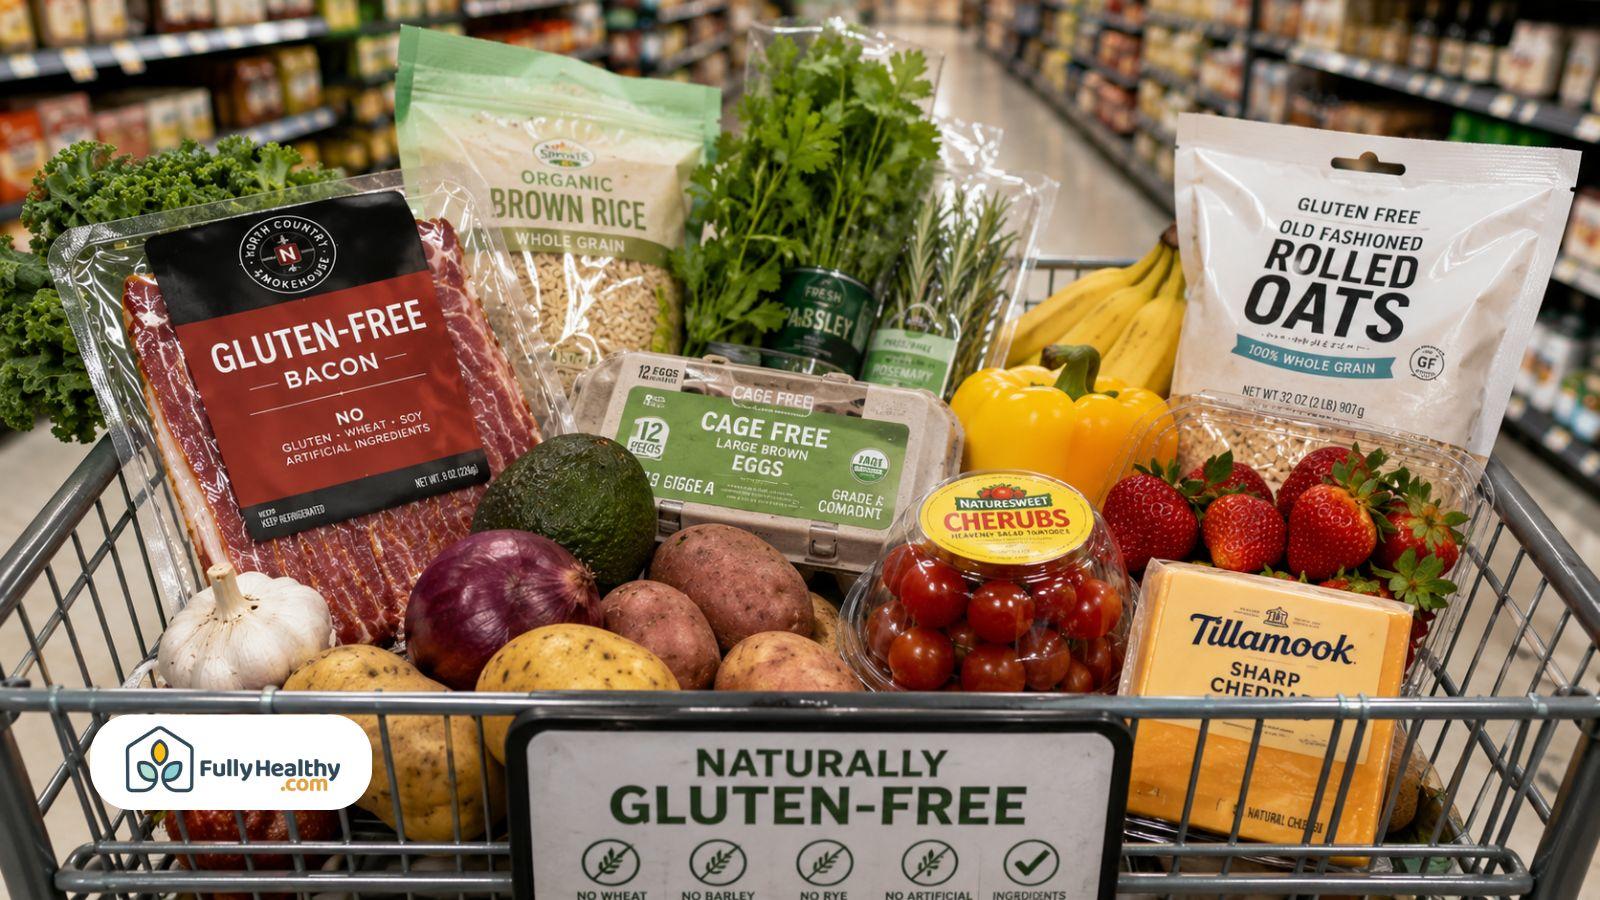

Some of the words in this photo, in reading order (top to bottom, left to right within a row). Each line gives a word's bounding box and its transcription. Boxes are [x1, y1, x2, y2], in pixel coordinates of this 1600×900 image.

[521, 170, 613, 192] ORGANIC
[490, 187, 584, 224] BROWN
[591, 197, 647, 231] RICE
[1297, 197, 1369, 220] GLUTEN
[1374, 207, 1421, 224] FREE
[245, 225, 271, 258] NORTH
[273, 219, 328, 247] COUNTRY
[515, 231, 571, 248] WHOLE
[576, 235, 625, 253] GRAIN
[1279, 220, 1315, 238] OLD
[1319, 227, 1423, 251] FASHIONED
[279, 246, 297, 262] N
[1264, 238, 1419, 289] ROLLED
[805, 286, 842, 303] FRESH
[1244, 274, 1411, 343] OATS
[210, 299, 427, 374] GLUTEN-FREE
[1248, 343, 1279, 362] 100%
[1283, 354, 1330, 372] WHOLE
[1334, 360, 1376, 374] GRAIN
[1417, 356, 1437, 369] GF
[284, 352, 379, 390] BACON
[638, 364, 650, 379] 12
[652, 366, 679, 378] EGGS
[732, 385, 772, 404] CAGE
[776, 391, 814, 410] FREE
[1242, 385, 1261, 398] NET
[1263, 388, 1279, 401] WT
[1280, 391, 1293, 404] 32
[1294, 394, 1308, 406] OZ
[1309, 396, 1320, 408] (2
[1321, 398, 1337, 412] LB)
[335, 407, 364, 426] NO
[282, 433, 332, 453] GLUTEN
[344, 420, 386, 438] WHEAT
[400, 411, 423, 425] SOY
[640, 421, 663, 443] 12
[701, 411, 765, 439] CAGE
[770, 421, 831, 449] FREE
[286, 442, 352, 466] ARTIFICIAL
[355, 423, 431, 449] INGREDIENTS
[716, 437, 758, 454] LARGE
[761, 444, 809, 460] BROWN
[731, 454, 784, 477] EGGS
[414, 476, 429, 488] NET
[832, 489, 874, 506] GRADE
[959, 496, 1049, 509] NATURESWEET
[943, 508, 1071, 532] CHERUBS
[1230, 661, 1300, 687] SHARP
[1210, 677, 1312, 697] CHEDD
[697, 748, 948, 778] NATURALLY
[609, 785, 1028, 826] GLUTEN-FREE
[1248, 807, 1285, 826] NATURAL
[577, 891, 596, 900] NO
[600, 891, 648, 900] WHEAT
[682, 891, 701, 900] NO
[705, 891, 755, 900] BARLEY
[800, 891, 819, 900] NO
[823, 891, 848, 900] RYE
[885, 891, 904, 900] NO
[907, 891, 972, 900] ARTIFICIAL
